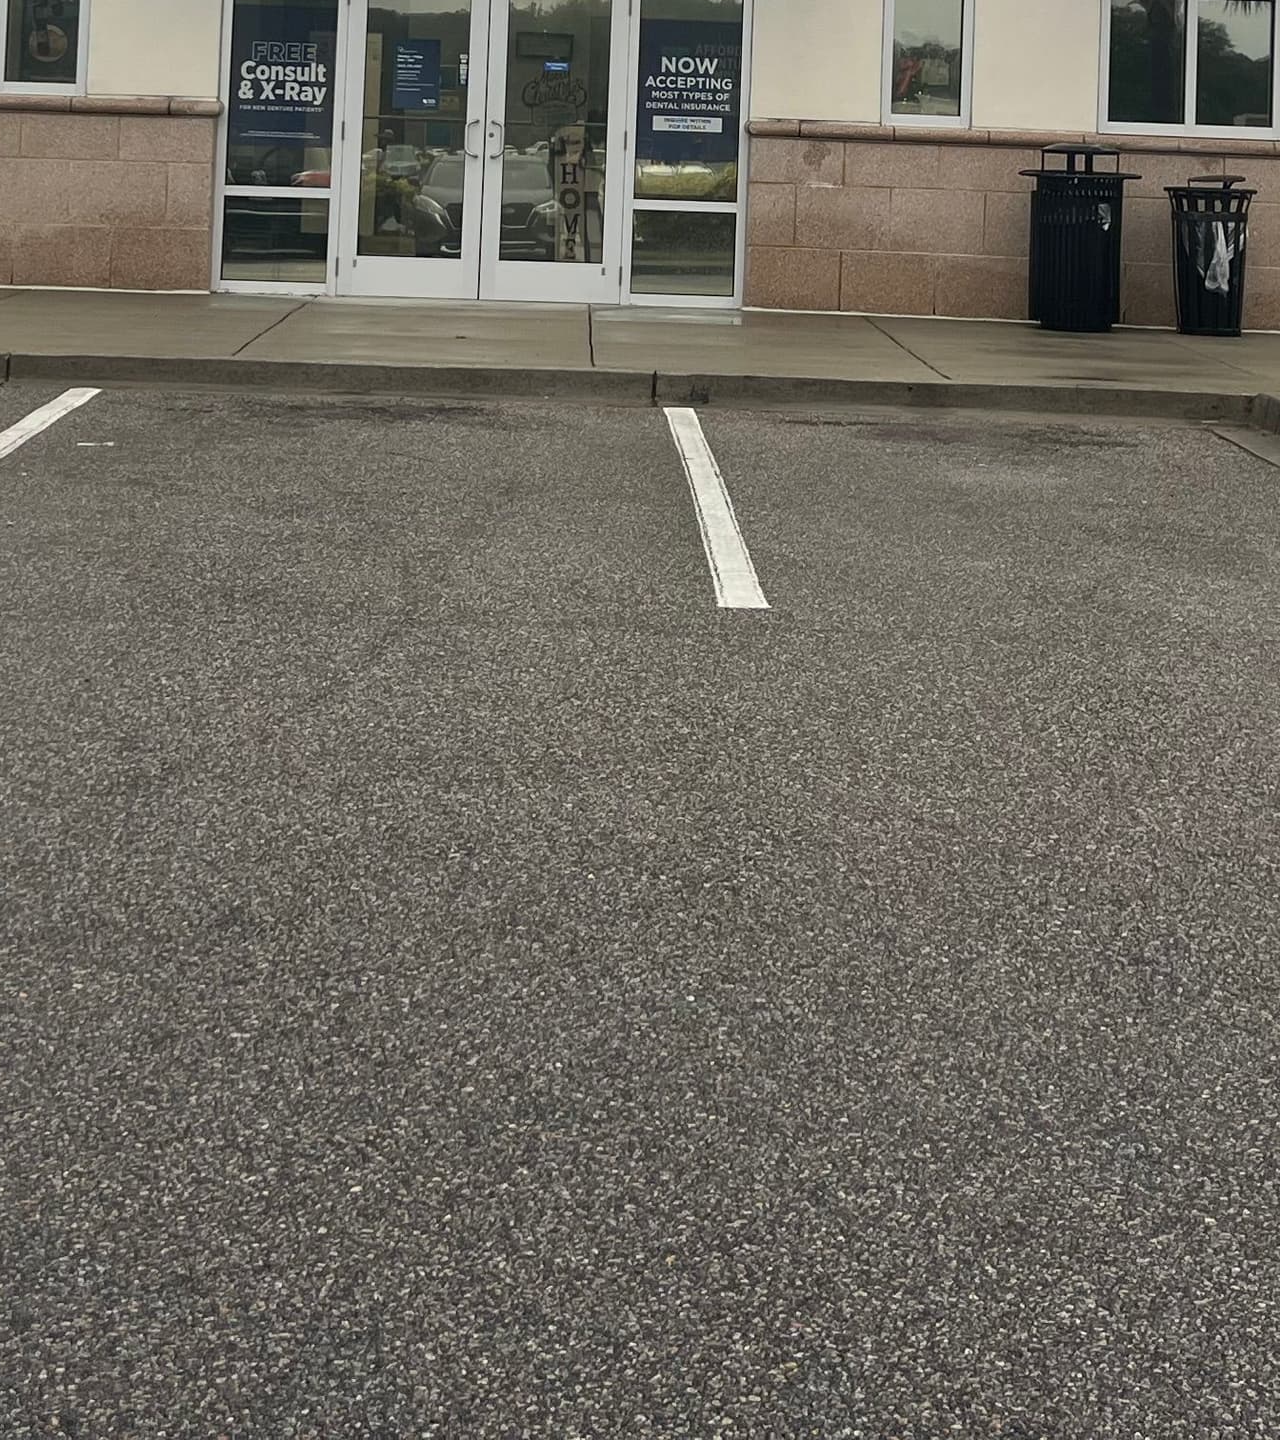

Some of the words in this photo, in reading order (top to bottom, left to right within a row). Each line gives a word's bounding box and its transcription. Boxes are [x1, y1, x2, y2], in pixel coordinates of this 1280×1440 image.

[252, 41, 317, 63] FREE
[241, 60, 327, 82] Consult
[661, 56, 718, 74] NOW
[645, 75, 732, 90] ACCEPTING
[238, 80, 254, 99] &
[260, 81, 327, 105] X-Ray
[651, 91, 679, 99] MOST
[682, 92, 713, 101] TYPES
[715, 93, 730, 101] OF
[645, 101, 679, 110] DENTAL
[681, 103, 731, 112] INSURANCE
